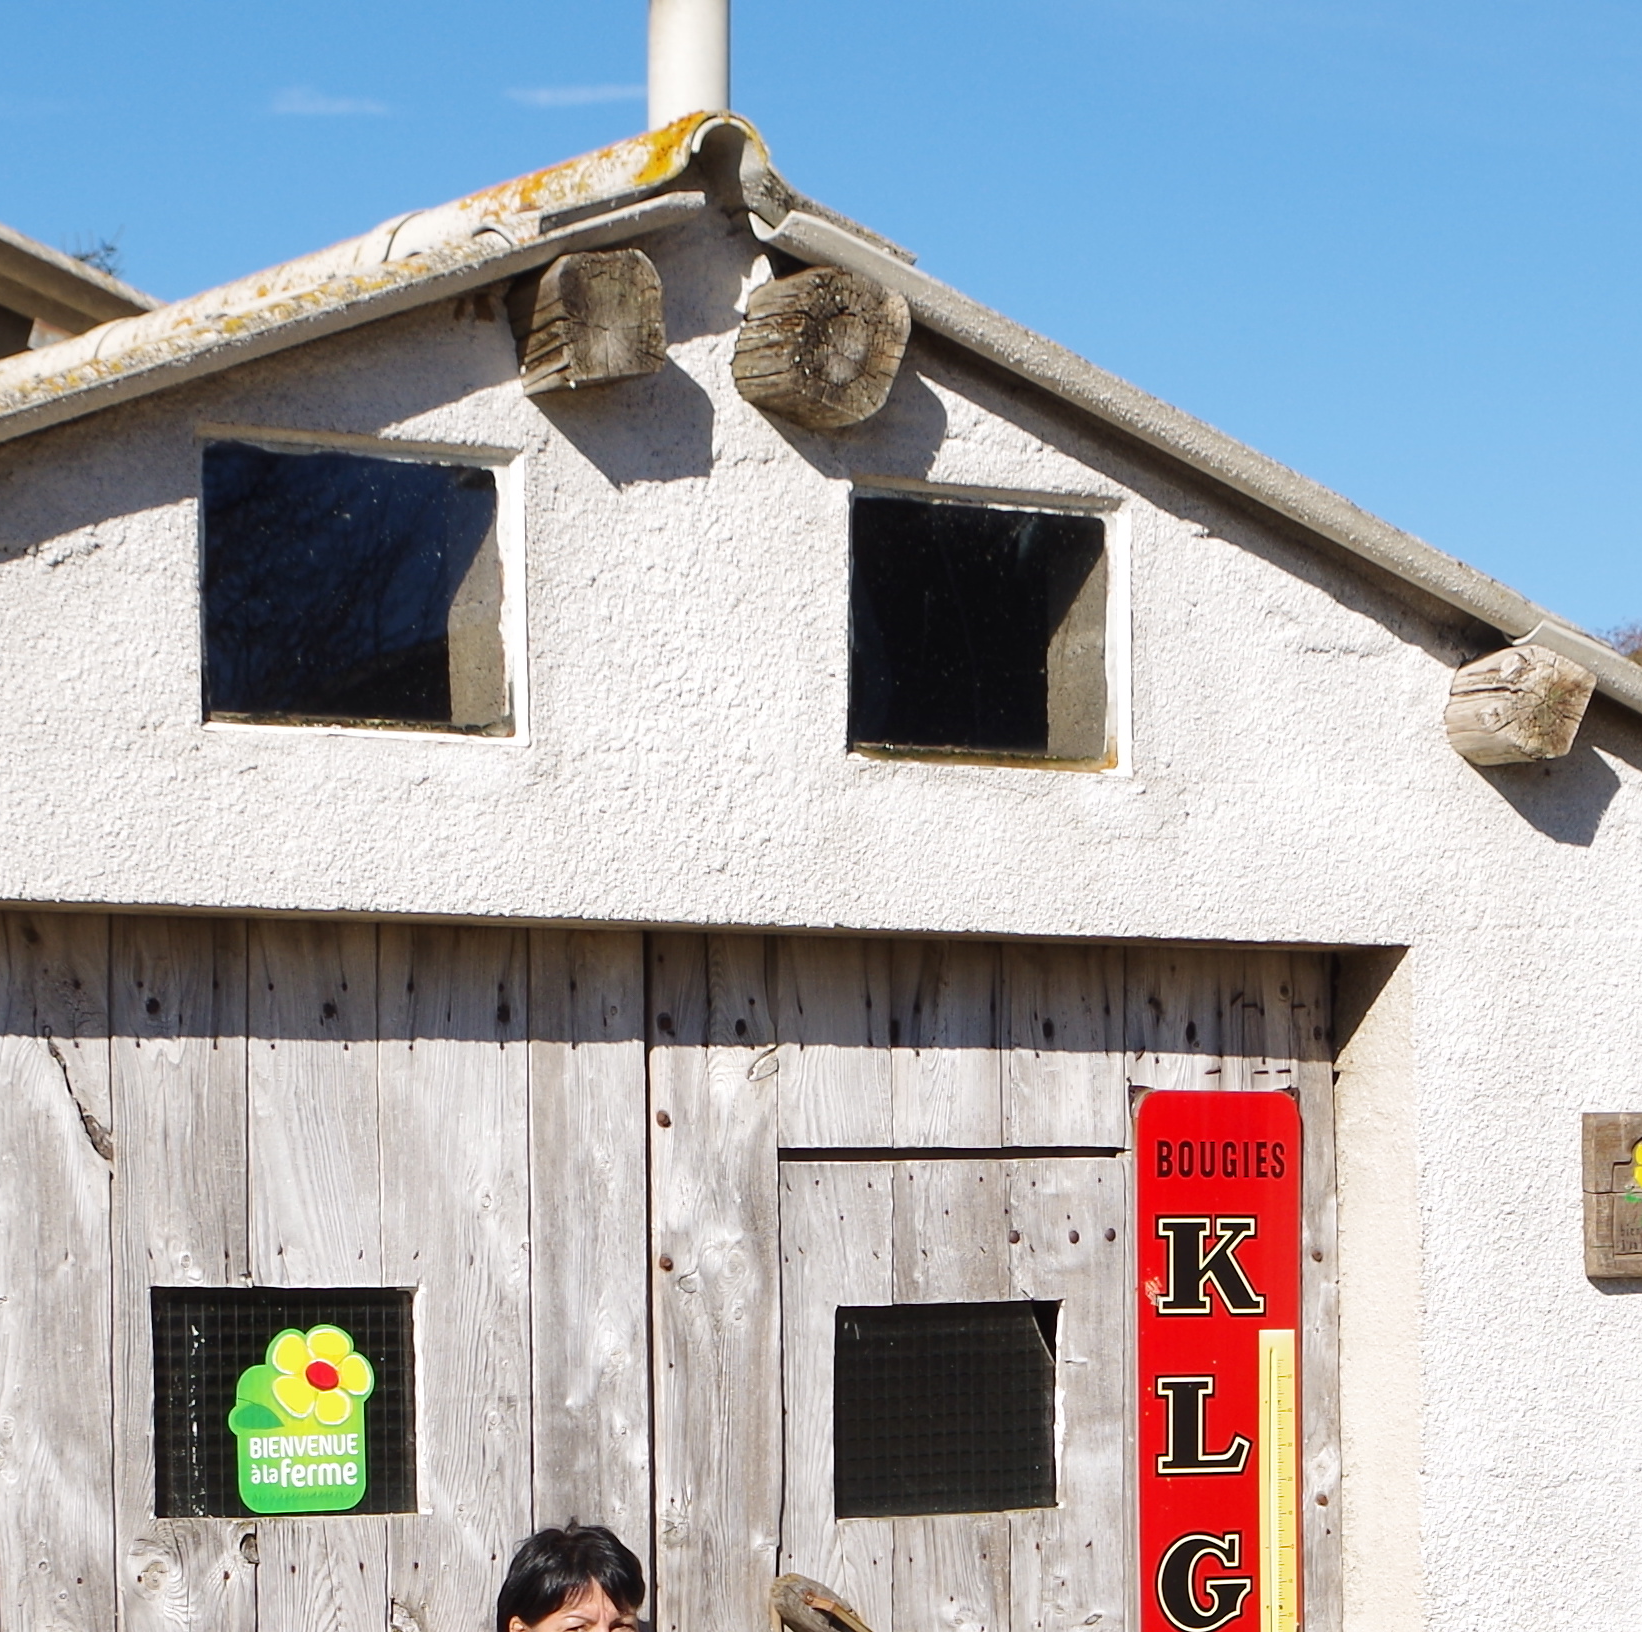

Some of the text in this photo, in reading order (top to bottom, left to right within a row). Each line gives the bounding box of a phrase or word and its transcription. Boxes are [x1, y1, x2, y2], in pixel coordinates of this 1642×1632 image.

[1157, 1139, 1286, 1179] BOUGIES
[249, 1433, 359, 1459] BIENVENUE
[251, 1458, 358, 1488] à la ferme
